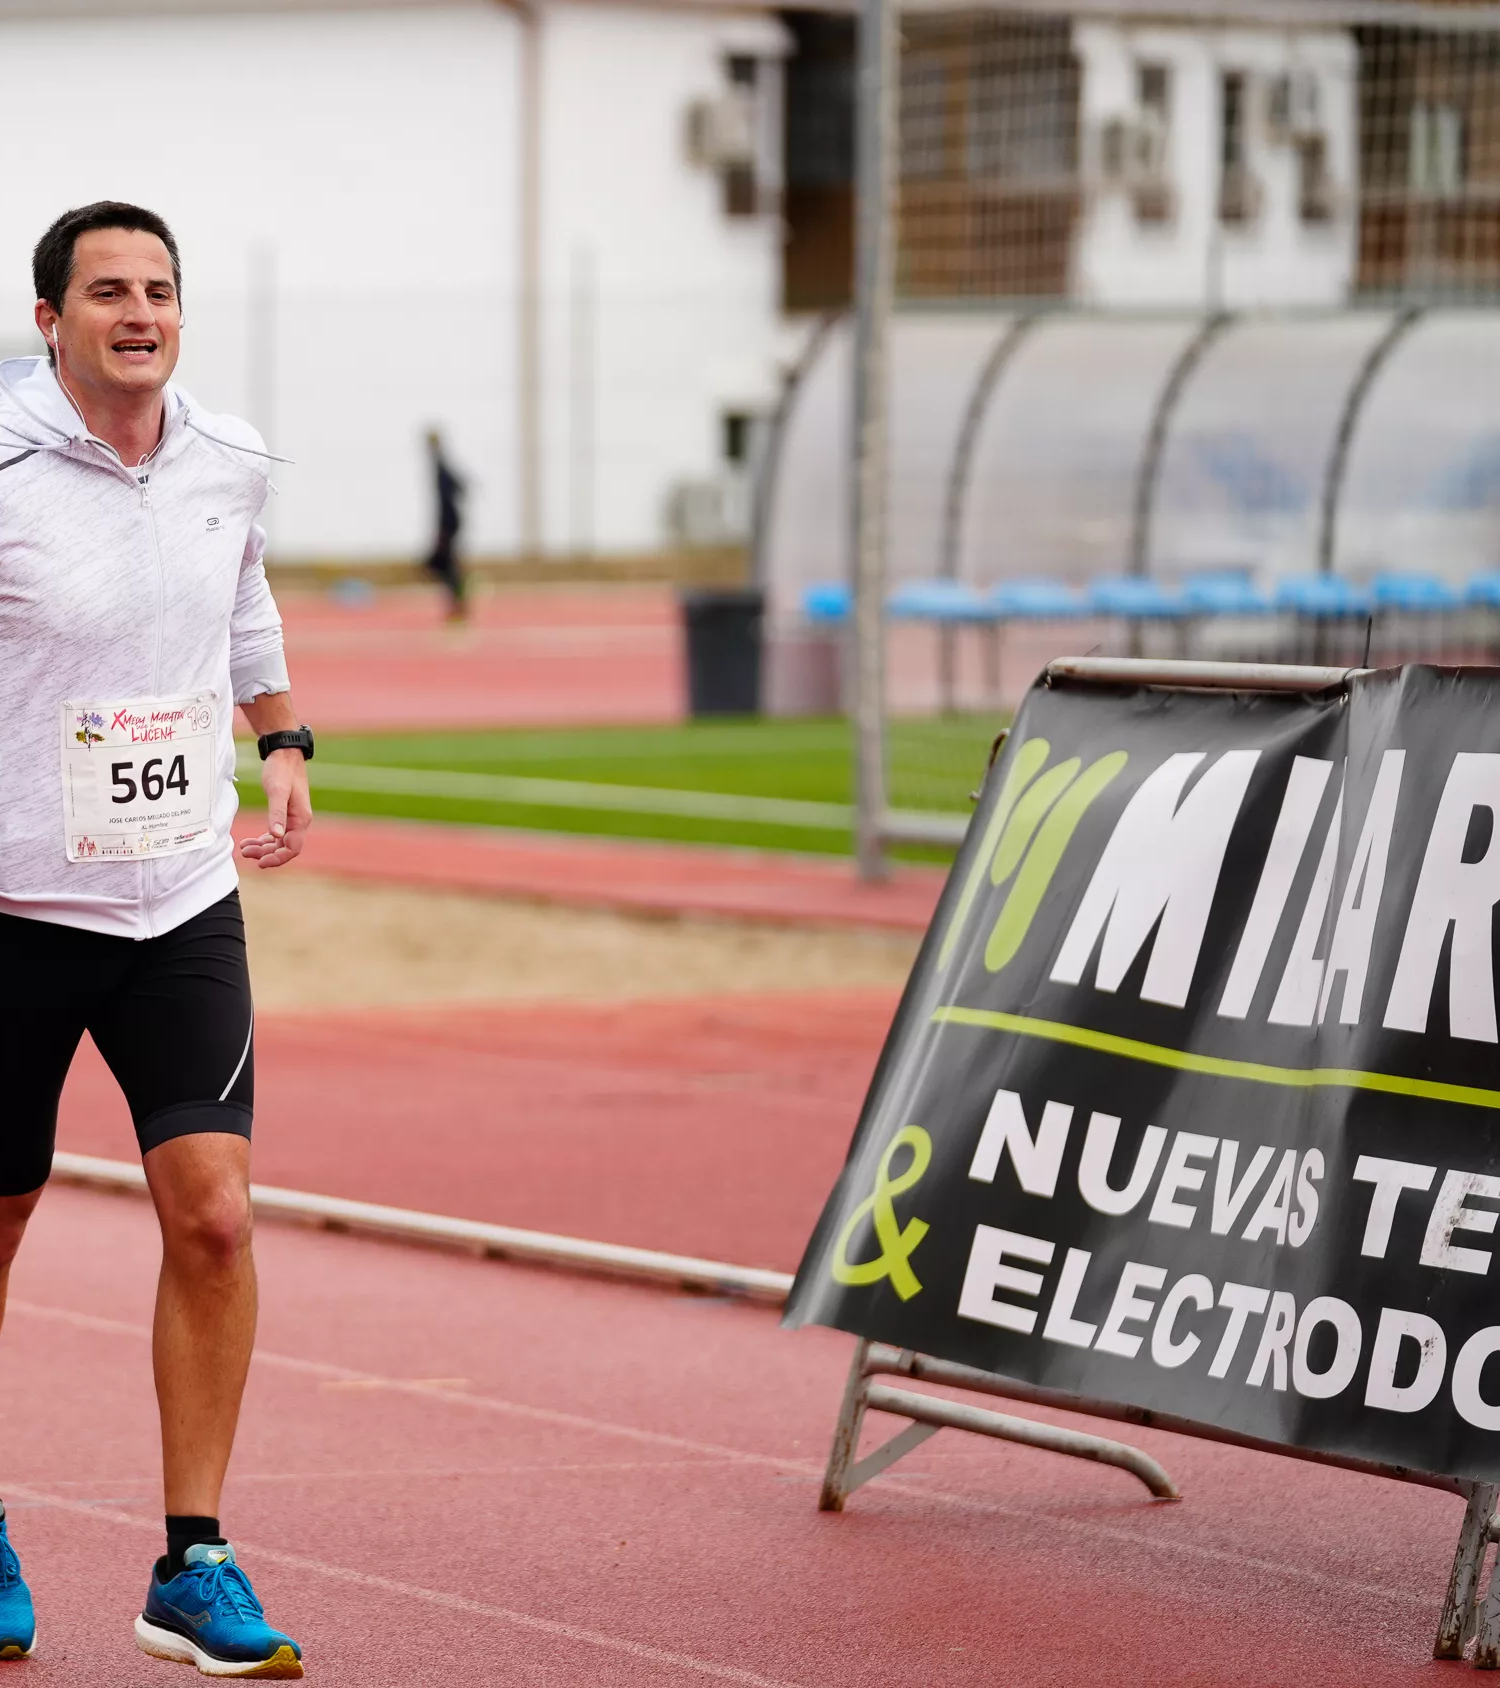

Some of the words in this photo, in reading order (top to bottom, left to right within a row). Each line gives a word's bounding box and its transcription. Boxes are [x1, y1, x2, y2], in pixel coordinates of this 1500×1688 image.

[131, 725, 177, 743] LUCENA
[111, 754, 190, 804] 564
[108, 817, 123, 825] JOSE
[124, 815, 147, 823] CARLOS
[968, 1089, 1325, 1248] NUEVAS
[832, 1125, 932, 1301] &
